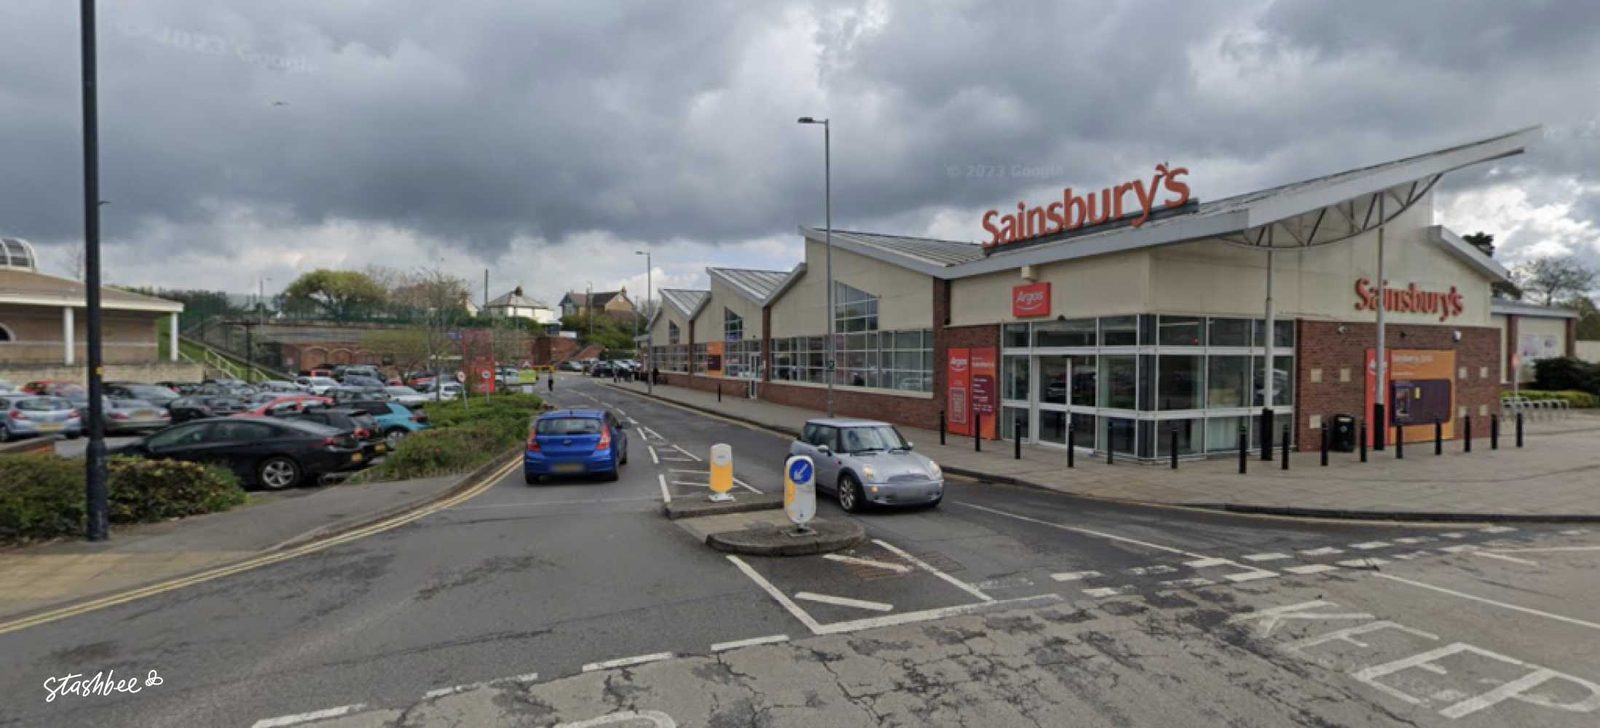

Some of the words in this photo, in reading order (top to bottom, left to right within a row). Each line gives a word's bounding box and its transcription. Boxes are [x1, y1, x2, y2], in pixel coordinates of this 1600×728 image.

[982, 162, 1190, 248] Sainsbury's
[1017, 290, 1044, 305] Argos
[1355, 277, 1463, 322] Sainsbury's
[1225, 600, 1600, 720] KEEP
